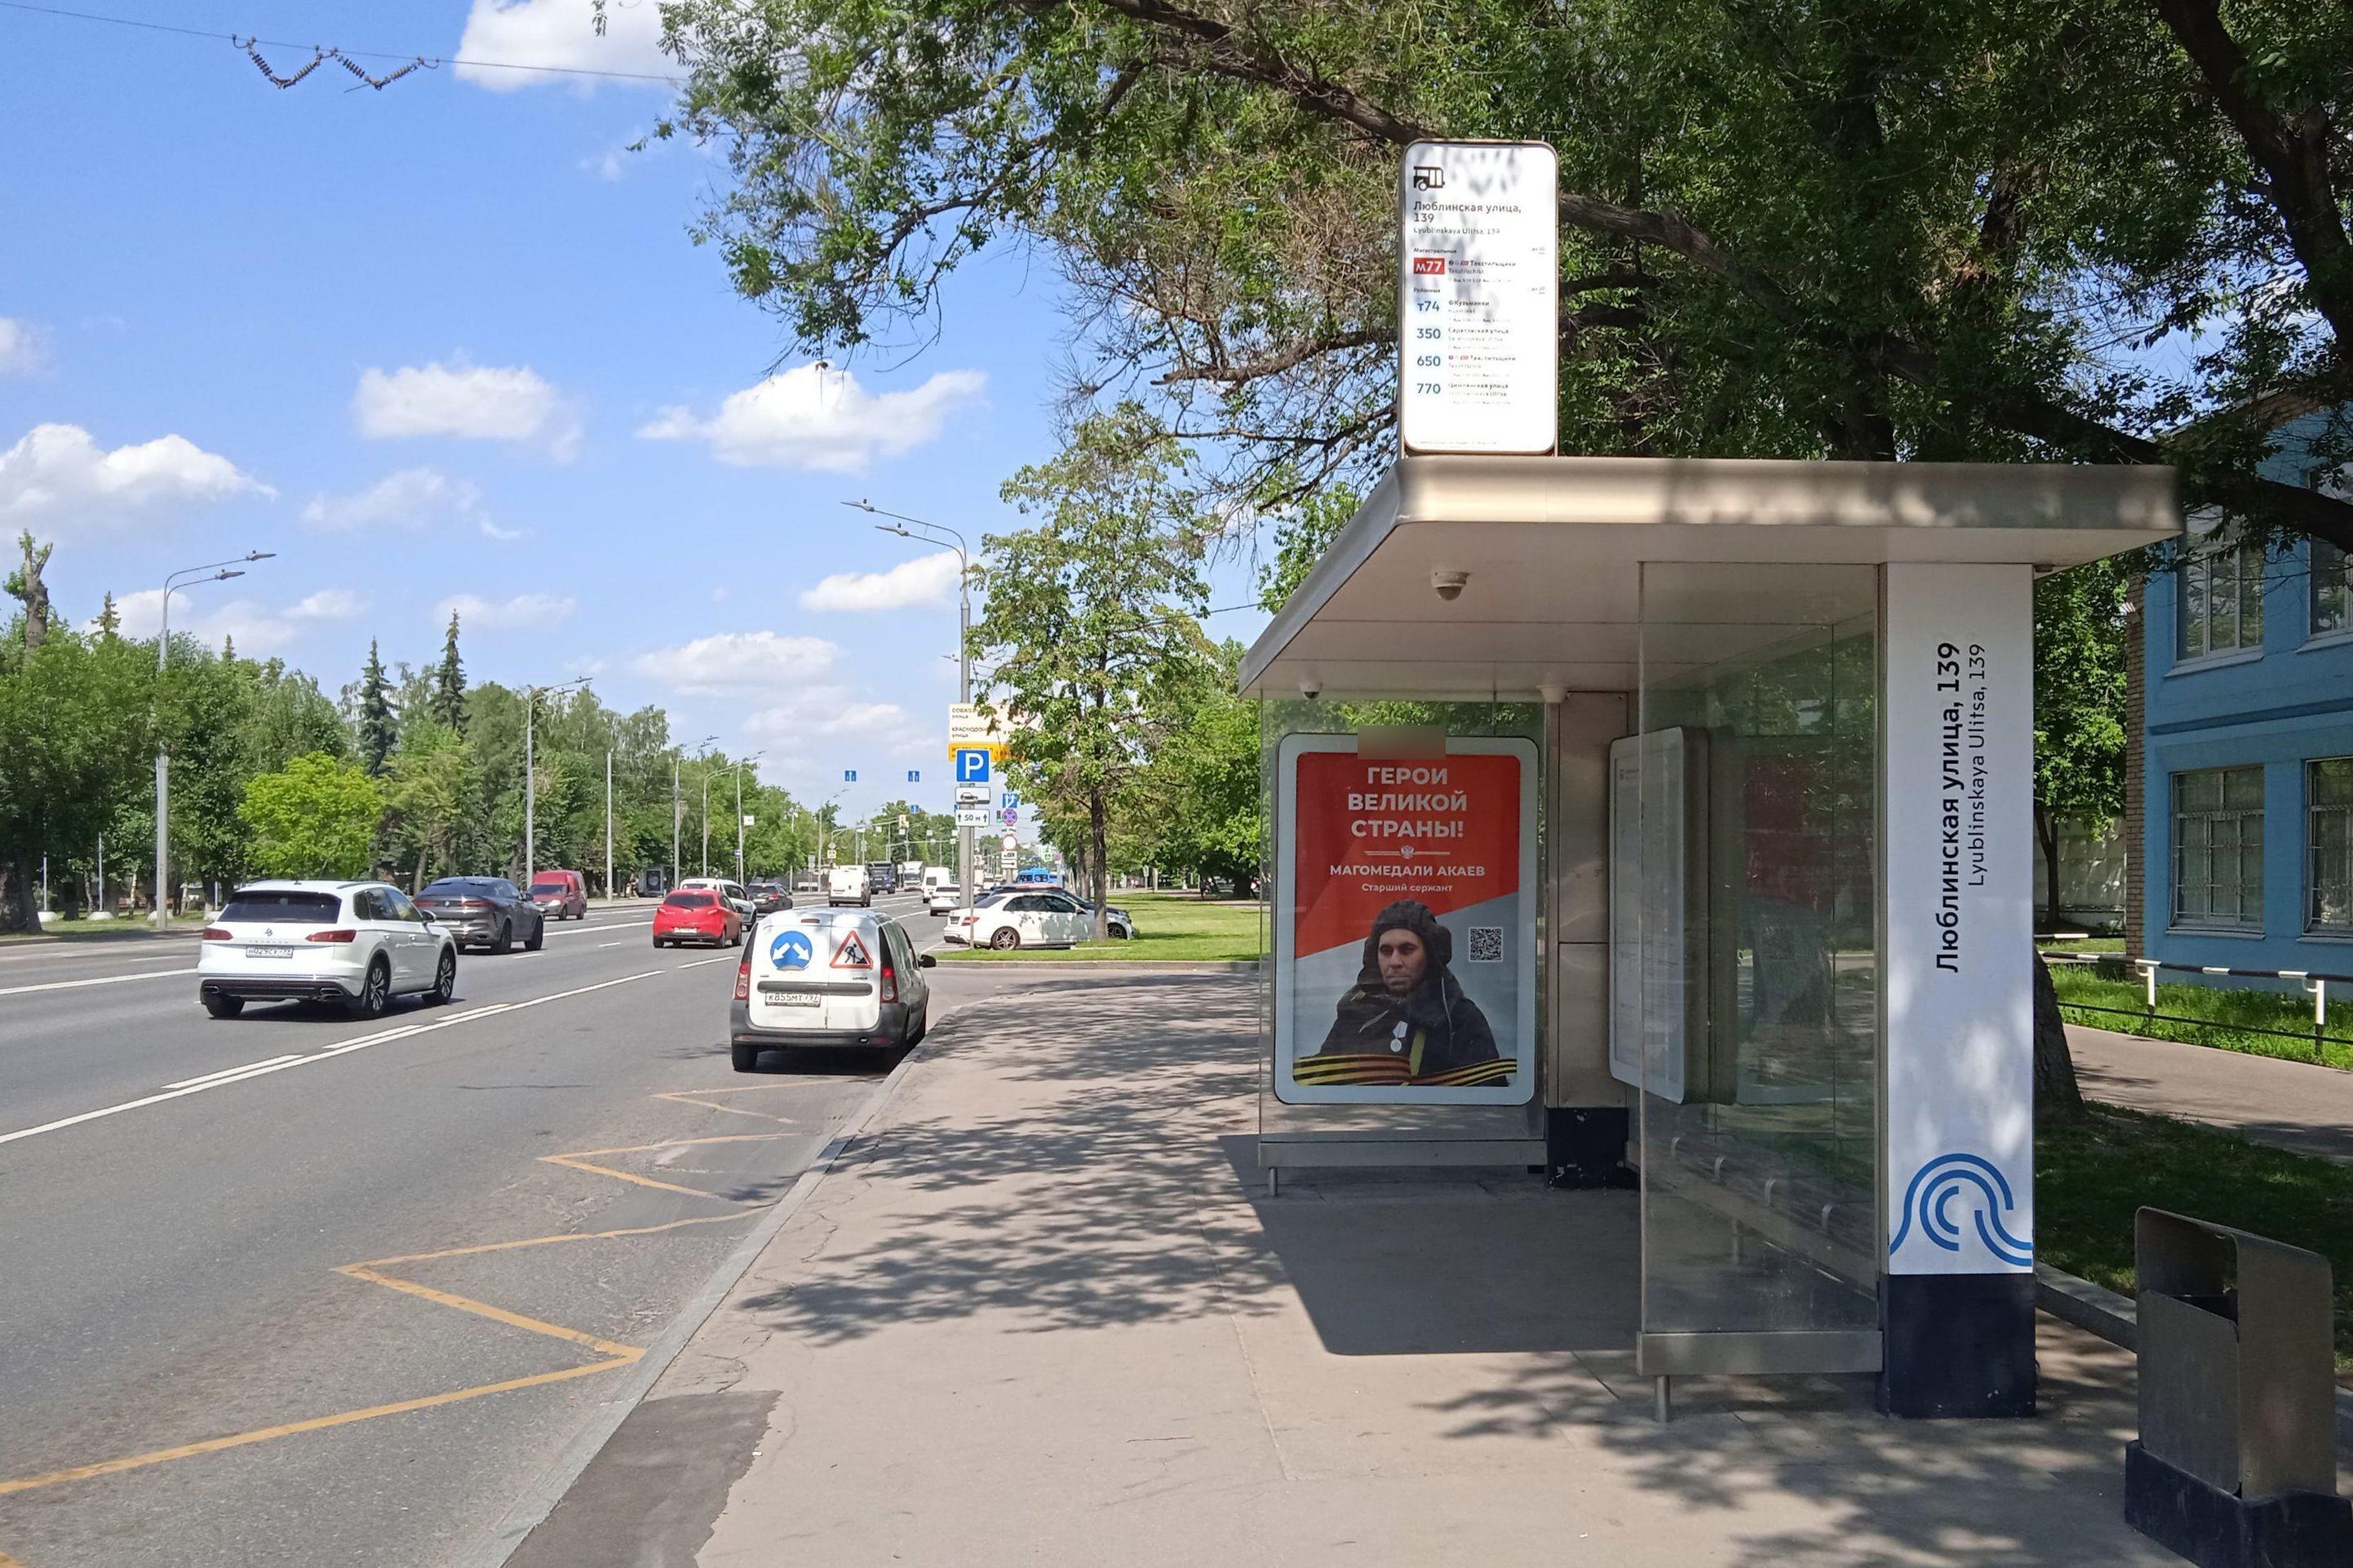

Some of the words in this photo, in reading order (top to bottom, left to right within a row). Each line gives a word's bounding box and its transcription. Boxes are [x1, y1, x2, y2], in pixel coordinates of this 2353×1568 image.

[1413, 201, 1483, 213] Люблинская
[1486, 203, 1522, 215] улица,
[1413, 213, 1435, 223] 139
[1416, 328, 1442, 339] 350
[1416, 355, 1442, 367] 650
[1416, 383, 1442, 395] 770
[1936, 642, 1961, 693] 139
[1968, 643, 1987, 680] 139
[1968, 685, 1988, 749] Ulitsa,
[1942, 700, 1965, 791] улица,
[1367, 767, 1448, 786] ГЕРОИ
[1347, 790, 1468, 812] ВЕЛИКОЙ
[1350, 820, 1465, 838] СТРАНЫ!
[1967, 754, 1989, 887] Lyublinskaya
[1329, 865, 1434, 878] МАГОМЕДАЛИ
[1436, 866, 1486, 877] АКАЕВ
[1361, 883, 1407, 893] Старший
[1409, 884, 1454, 894] сержант
[1935, 797, 1960, 974] Люблинская
